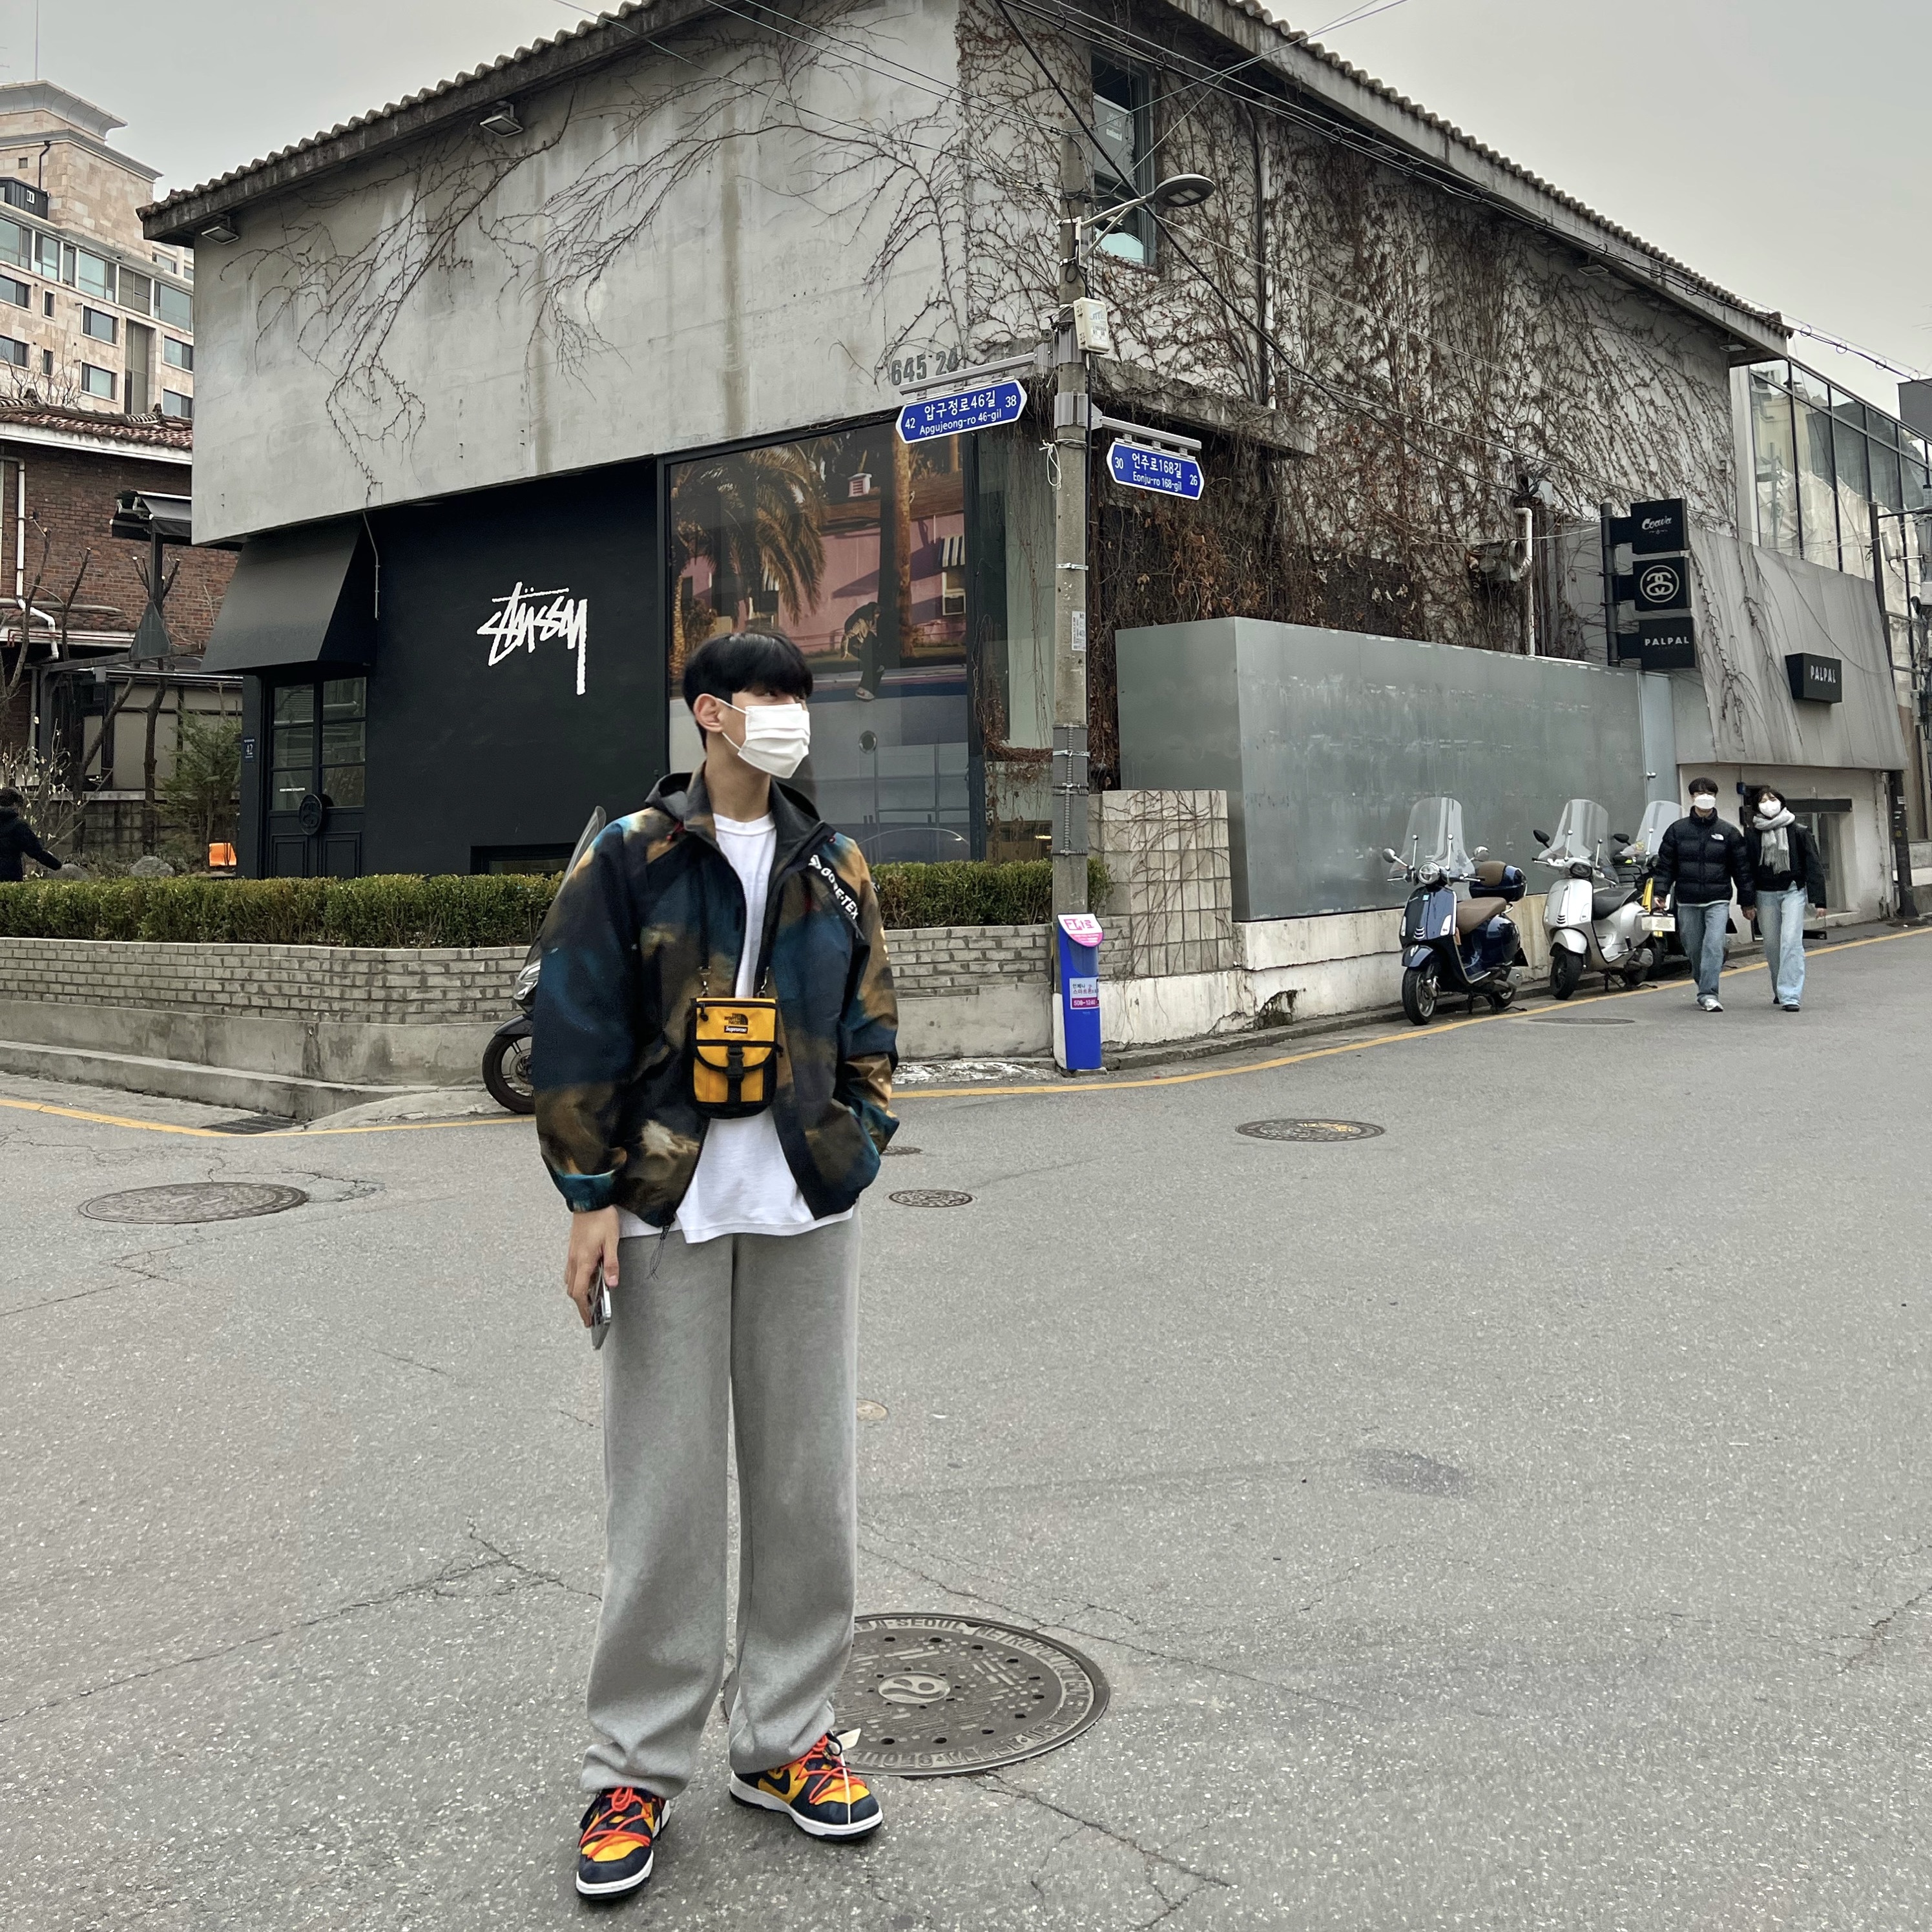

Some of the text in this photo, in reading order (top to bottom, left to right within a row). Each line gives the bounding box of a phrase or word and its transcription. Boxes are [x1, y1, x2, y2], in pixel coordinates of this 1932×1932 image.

[891, 355, 926, 386] 645
[924, 390, 995, 421] 압구정로46길
[1005, 395, 1017, 408] 38
[905, 418, 915, 429] 42
[919, 408, 1002, 436] Apgujeong-ro 46-gil
[1114, 457, 1124, 469] 30
[1132, 453, 1182, 479] 언주로168길
[1132, 471, 1182, 492] Eonju-ro 168-gil
[1189, 474, 1198, 486] 26
[1645, 636, 1690, 646] PALPAL
[1810, 665, 1836, 683] PALPAL
